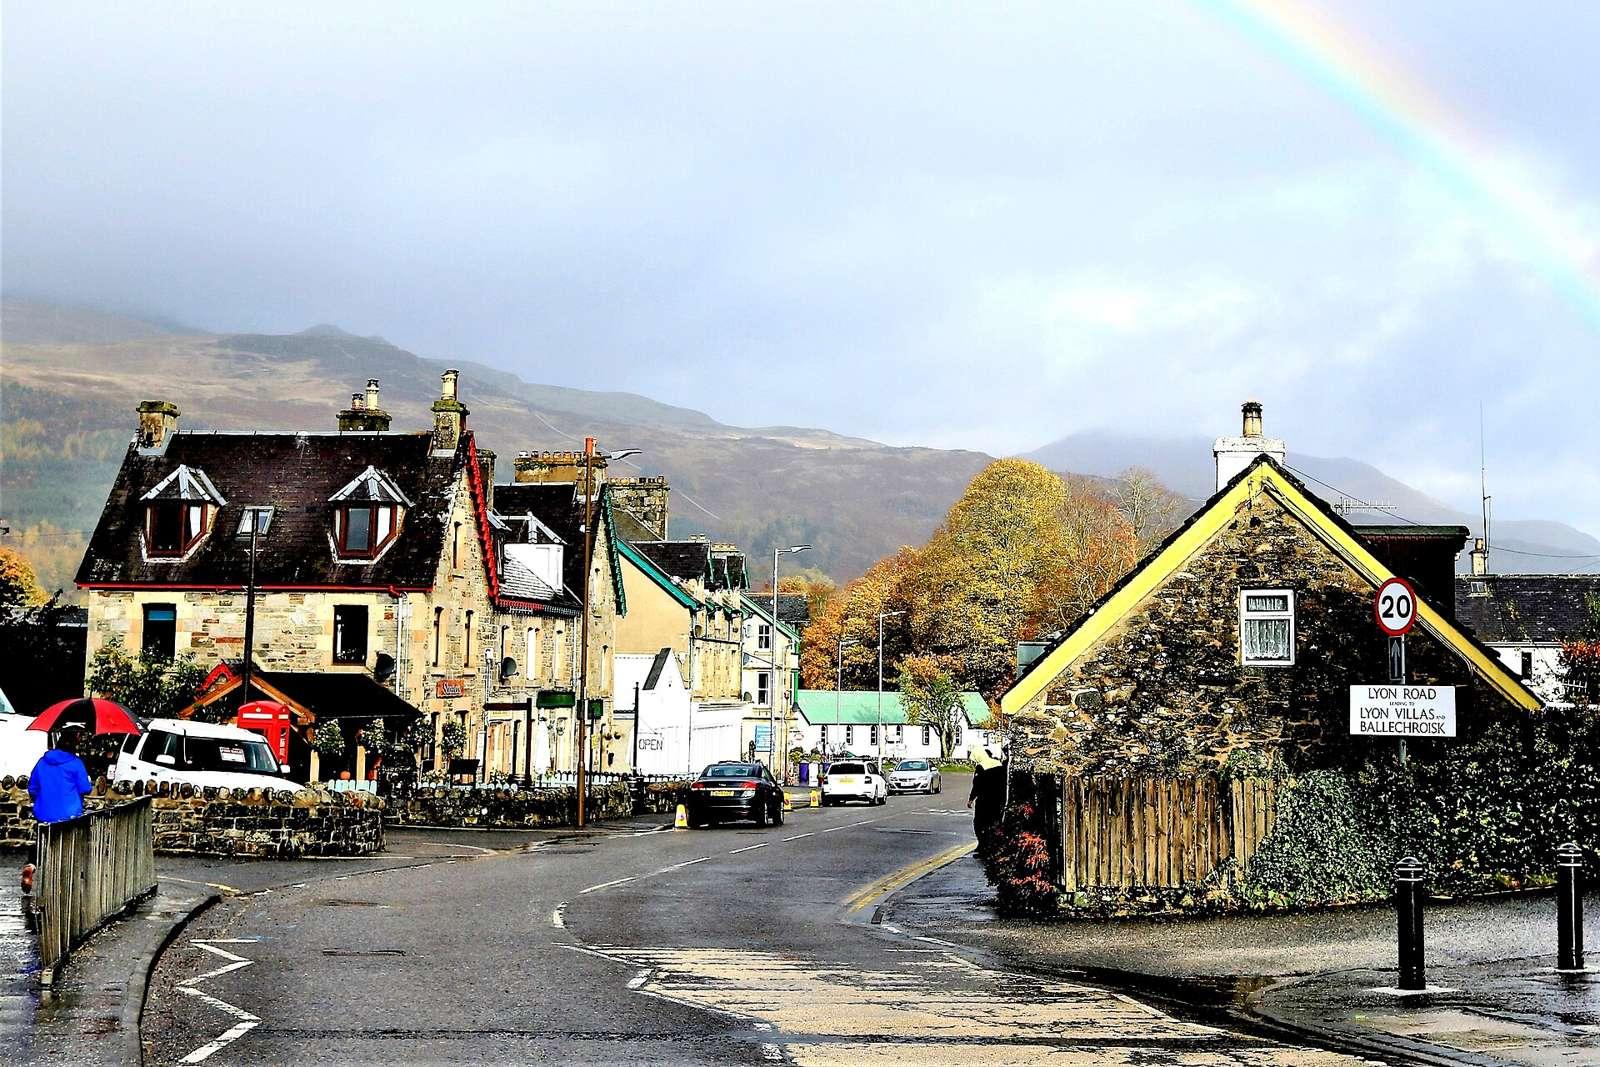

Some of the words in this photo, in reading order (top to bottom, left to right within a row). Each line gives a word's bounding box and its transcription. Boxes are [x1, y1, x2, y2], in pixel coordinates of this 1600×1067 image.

[1381, 594, 1411, 619] 20
[1368, 687, 1397, 699] LYON
[1403, 688, 1437, 700] ROAD
[1360, 707, 1389, 719] LYON
[1394, 708, 1435, 720] VILLAS
[1360, 720, 1446, 734] BALLECHROISK
[638, 738, 663, 751] OPEN
